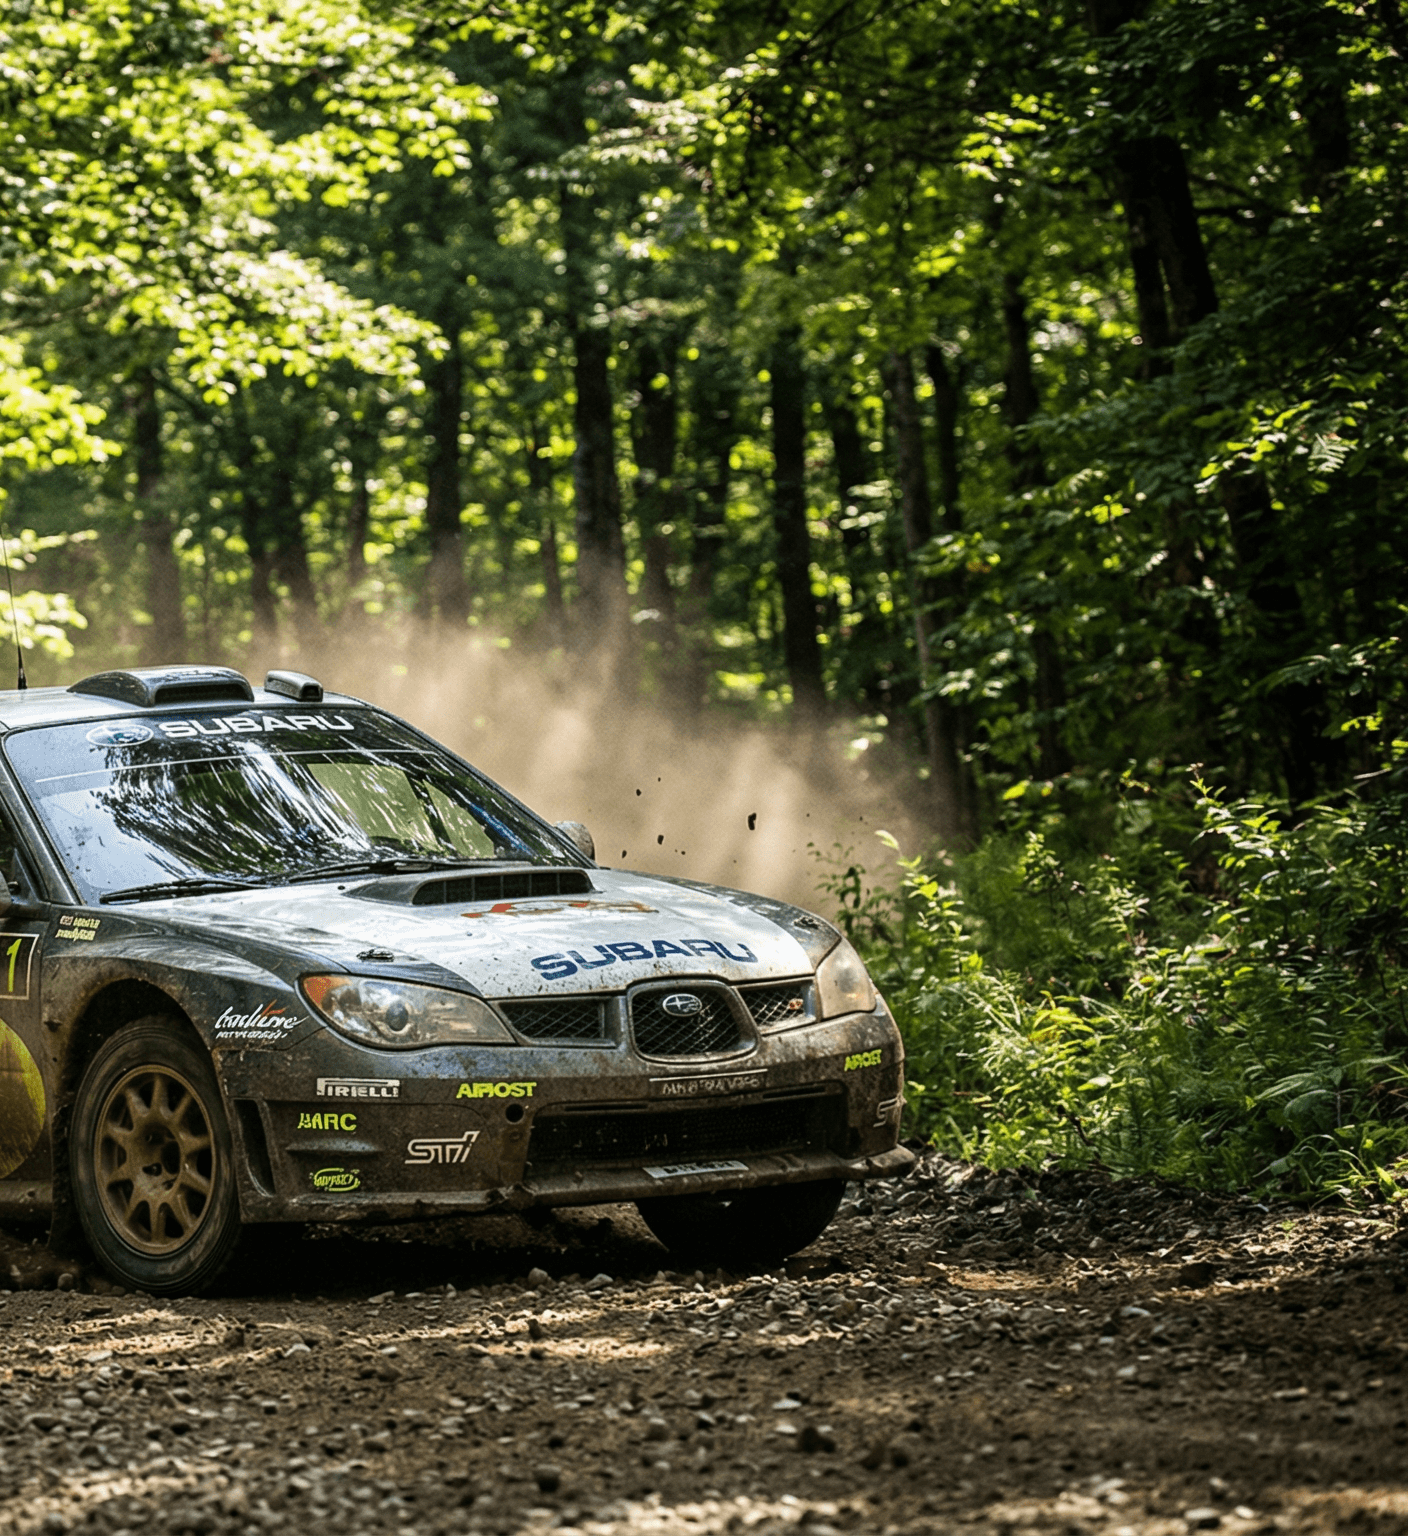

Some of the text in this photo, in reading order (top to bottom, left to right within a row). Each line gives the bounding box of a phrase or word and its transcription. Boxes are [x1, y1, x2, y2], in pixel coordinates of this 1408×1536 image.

[159, 715, 354, 738] SUBARU
[6, 938, 22, 993] 1
[530, 939, 759, 981] SUBARU
